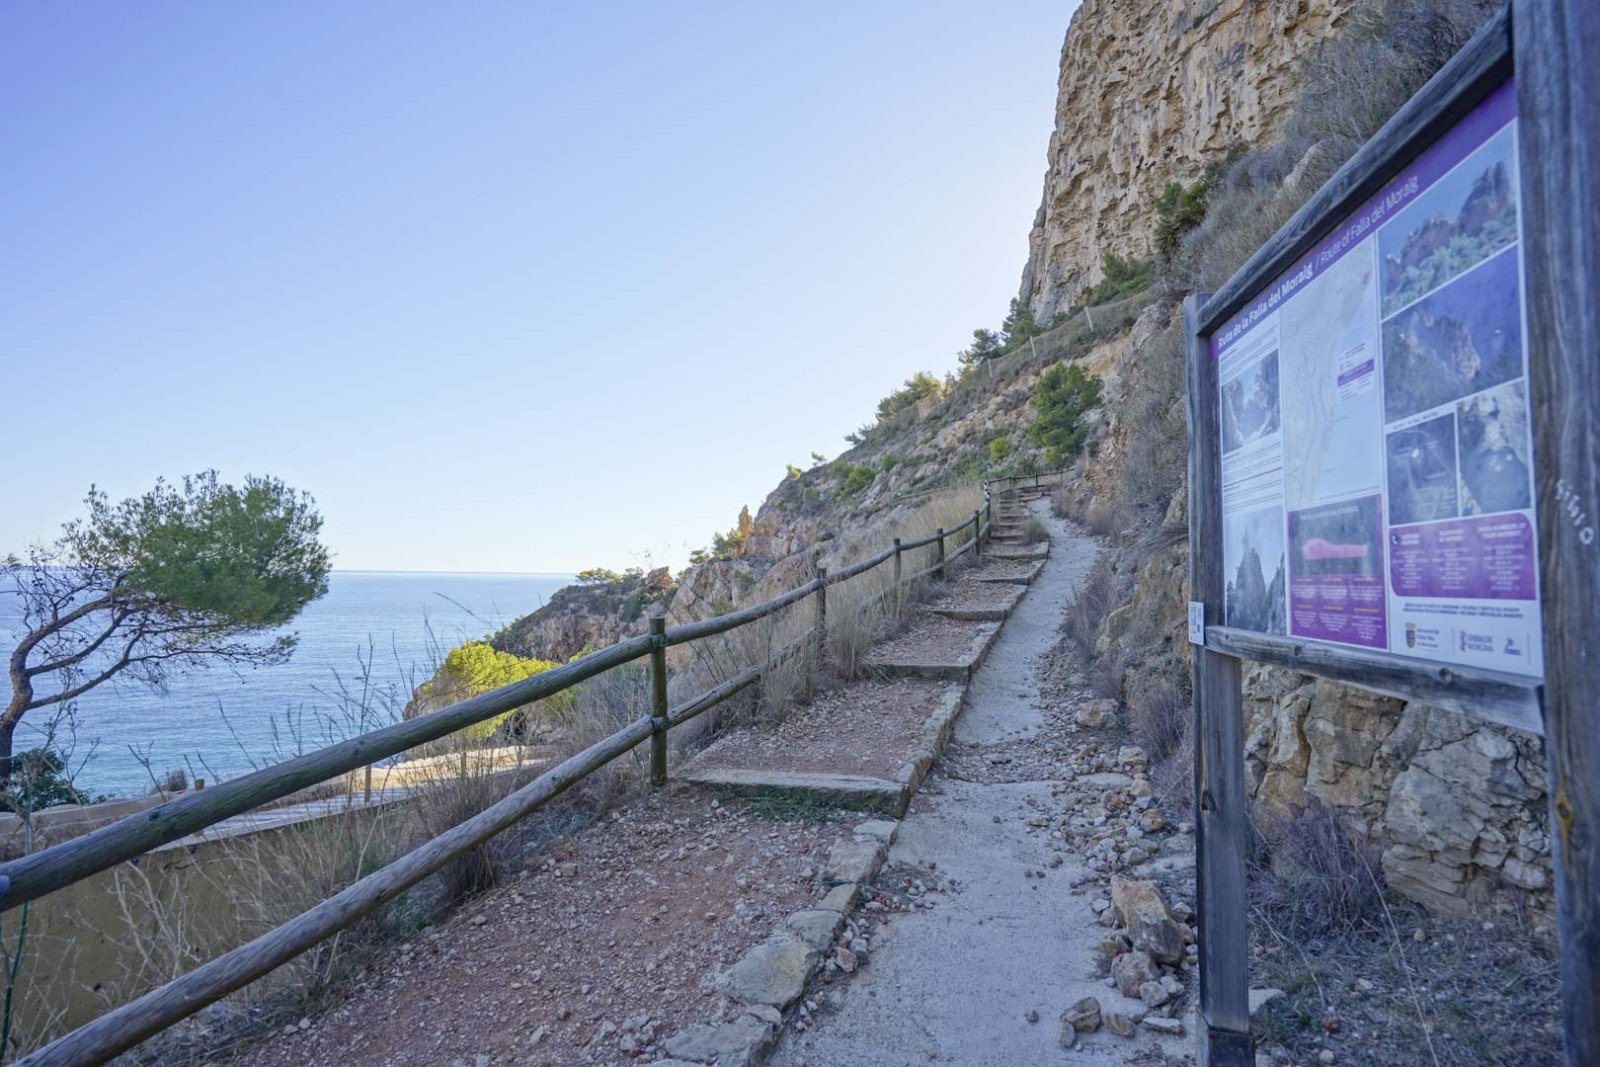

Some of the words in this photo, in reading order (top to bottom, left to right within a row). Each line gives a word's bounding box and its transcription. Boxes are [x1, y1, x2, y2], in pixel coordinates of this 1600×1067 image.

[1218, 332, 1233, 351] Ruta
[1233, 324, 1242, 338] de
[1242, 318, 1249, 330] la
[1249, 302, 1268, 324] Falla
[1269, 287, 1282, 309] del
[1282, 262, 1314, 297] Moraig
[1320, 241, 1342, 266] Route
[1342, 229, 1351, 249] of
[1351, 217, 1372, 241] Falla
[1372, 200, 1386, 224] del
[1386, 176, 1419, 212] Moraig
